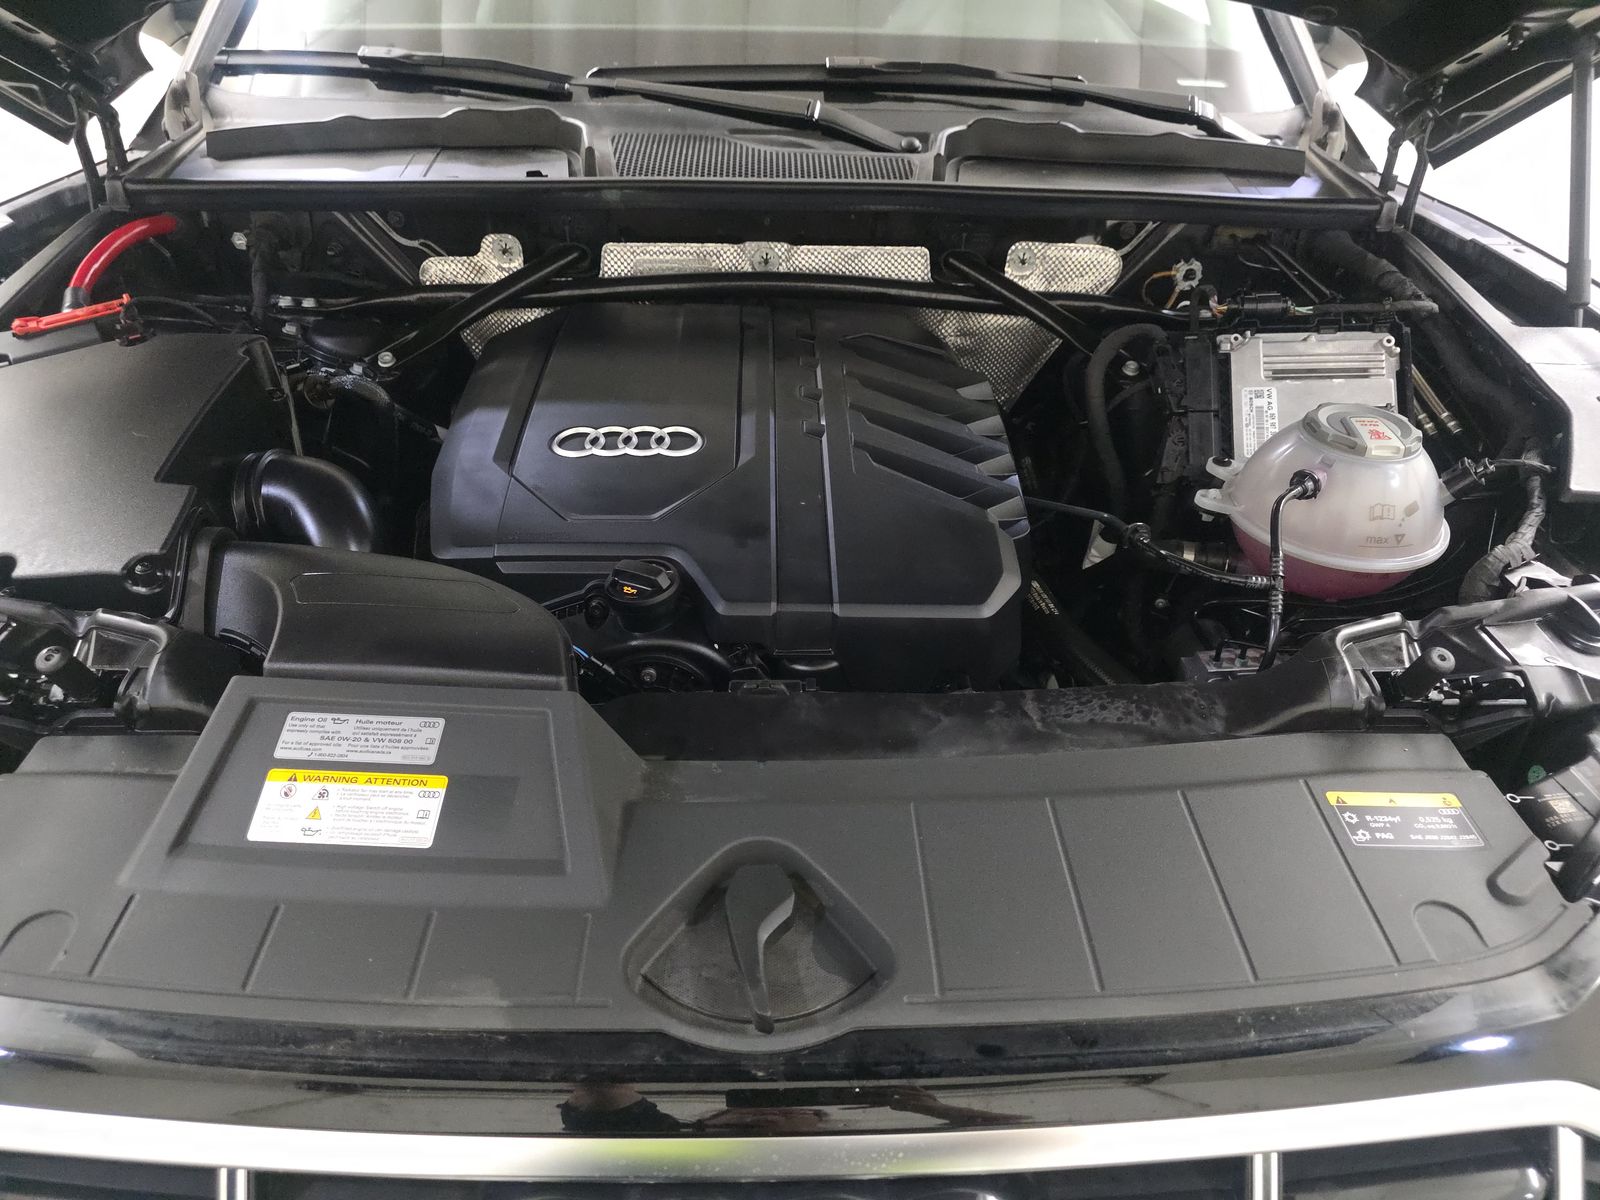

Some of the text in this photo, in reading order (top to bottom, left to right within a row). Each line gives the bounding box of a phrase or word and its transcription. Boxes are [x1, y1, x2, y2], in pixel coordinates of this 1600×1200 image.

[1266, 388, 1272, 400] VW
[1267, 401, 1273, 411] AG
[1366, 536, 1389, 544] max
[303, 775, 428, 786] WARNING ATTENTION
